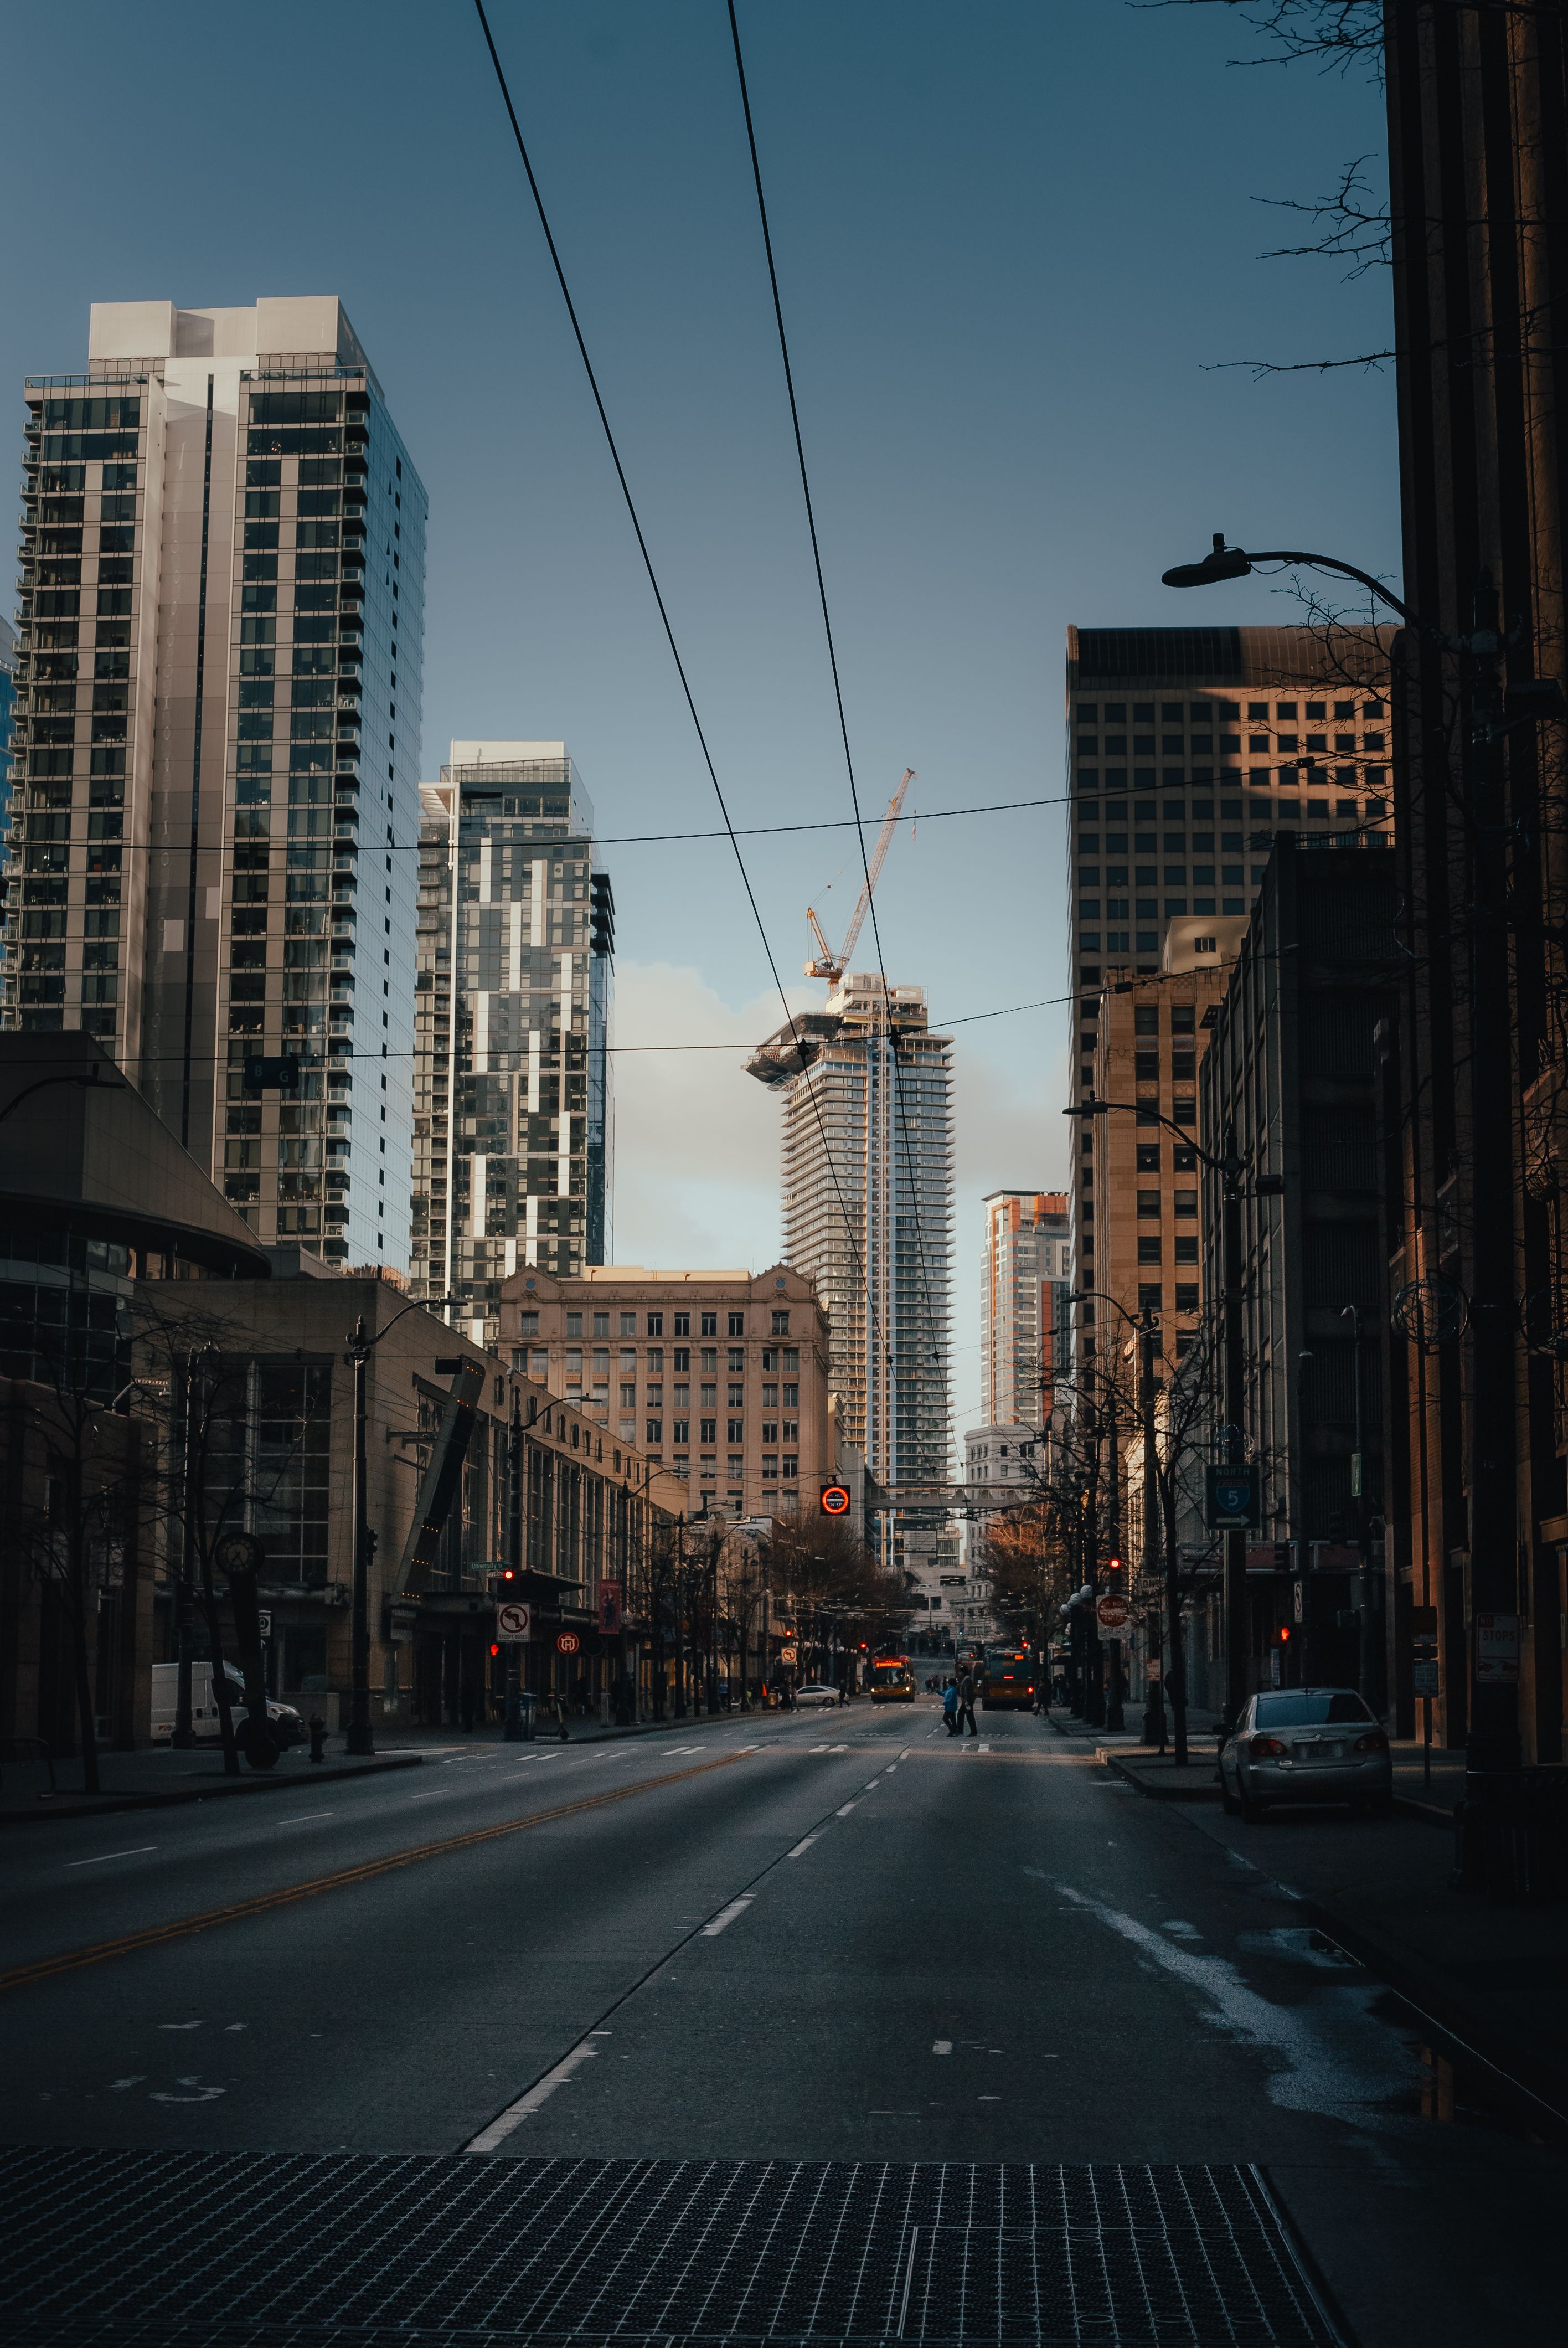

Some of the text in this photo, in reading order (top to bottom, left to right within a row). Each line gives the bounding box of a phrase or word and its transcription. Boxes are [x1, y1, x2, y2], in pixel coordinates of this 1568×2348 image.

[1216, 1468, 1250, 1476] NORTH
[1228, 1490, 1239, 1506] 5
[1480, 1616, 1492, 1626] NO
[1483, 1630, 1515, 1641] STOPS
